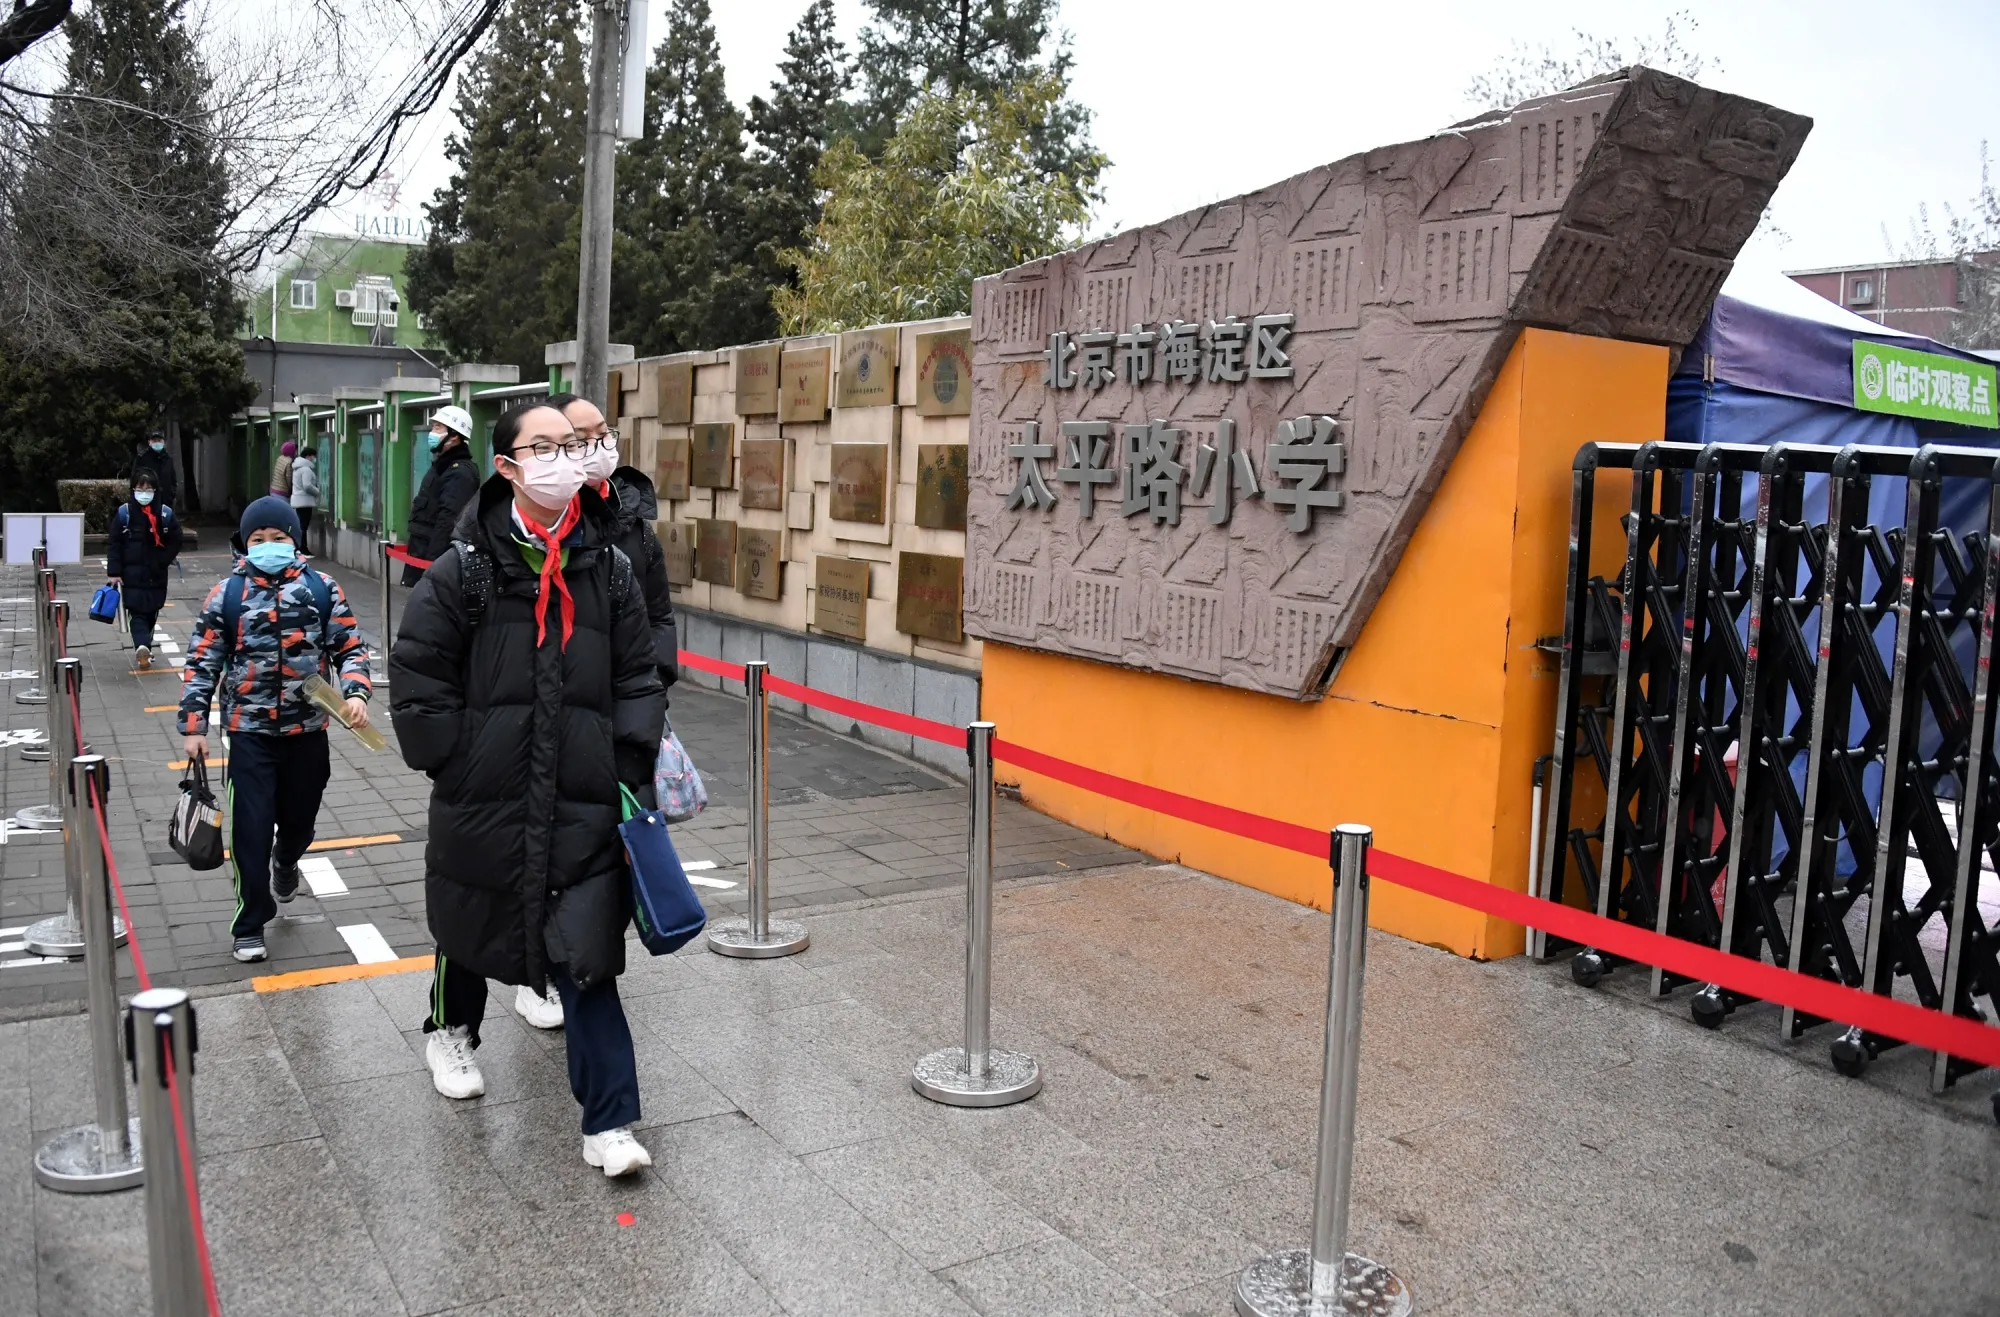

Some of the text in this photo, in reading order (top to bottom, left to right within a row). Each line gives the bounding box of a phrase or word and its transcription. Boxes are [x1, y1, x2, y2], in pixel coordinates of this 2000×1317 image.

[356, 213, 427, 241] HAIDIA
[1043, 313, 1296, 389] 北京市海淀区
[1886, 360, 1991, 415] 临时观察点
[1006, 415, 1347, 533] 太平路小学
